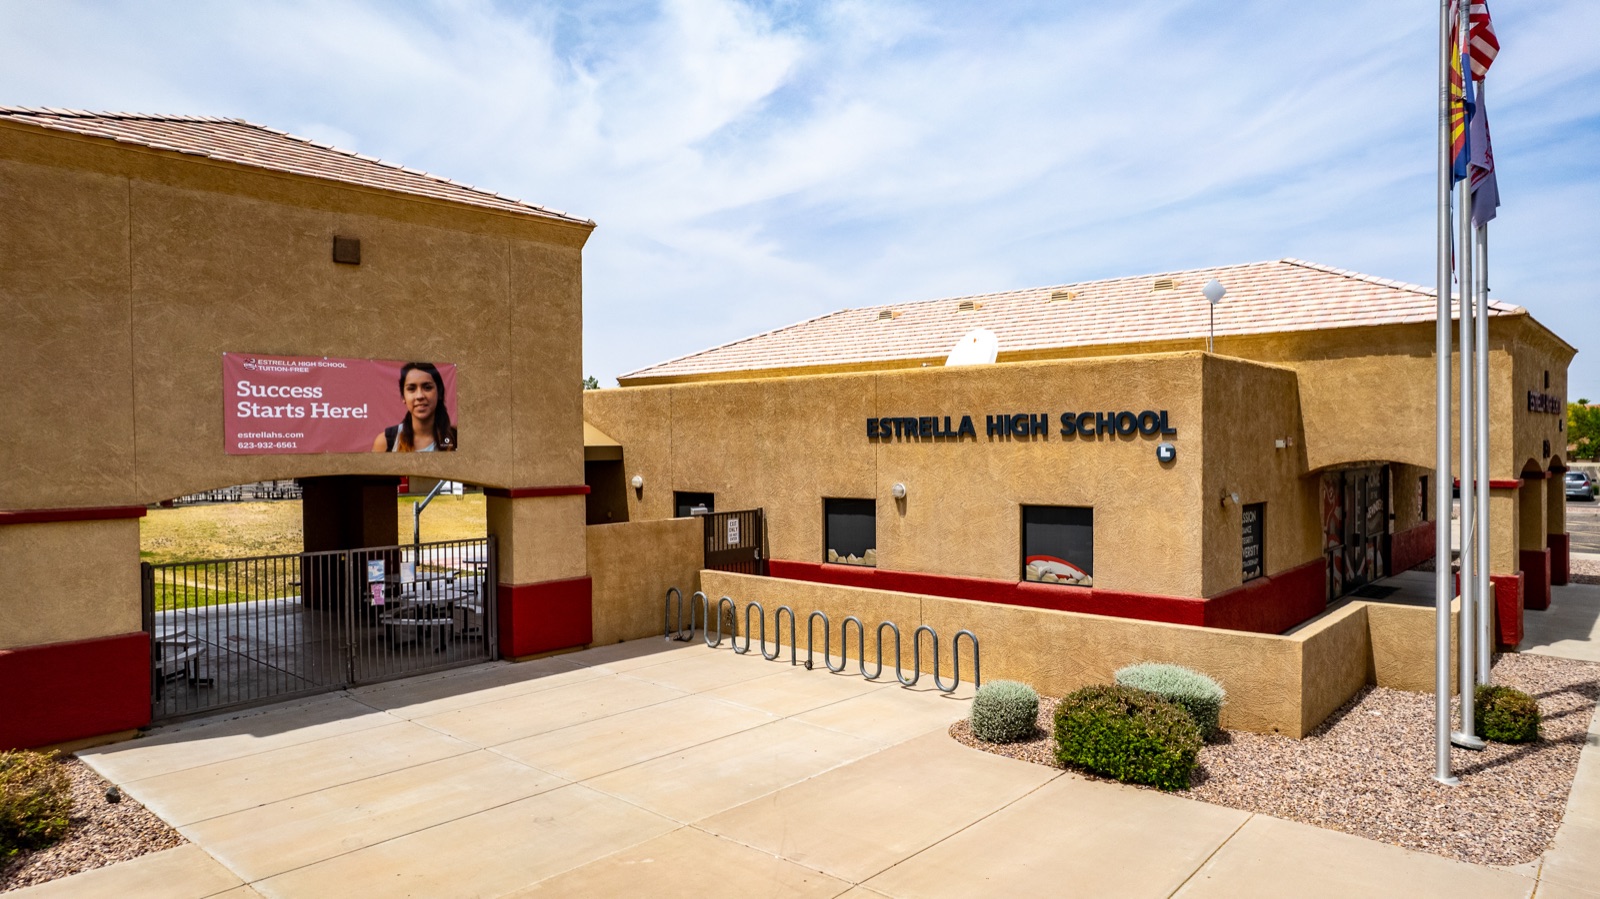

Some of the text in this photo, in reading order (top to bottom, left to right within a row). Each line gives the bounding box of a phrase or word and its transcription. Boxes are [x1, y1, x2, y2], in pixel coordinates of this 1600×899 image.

[258, 359, 297, 367] ESTRELLA
[236, 380, 323, 398] Success
[237, 401, 368, 419] Starts Here!
[866, 410, 1176, 438] ESTRELLA HIGH SCHOOL
[237, 431, 304, 439] estrellahs.com
